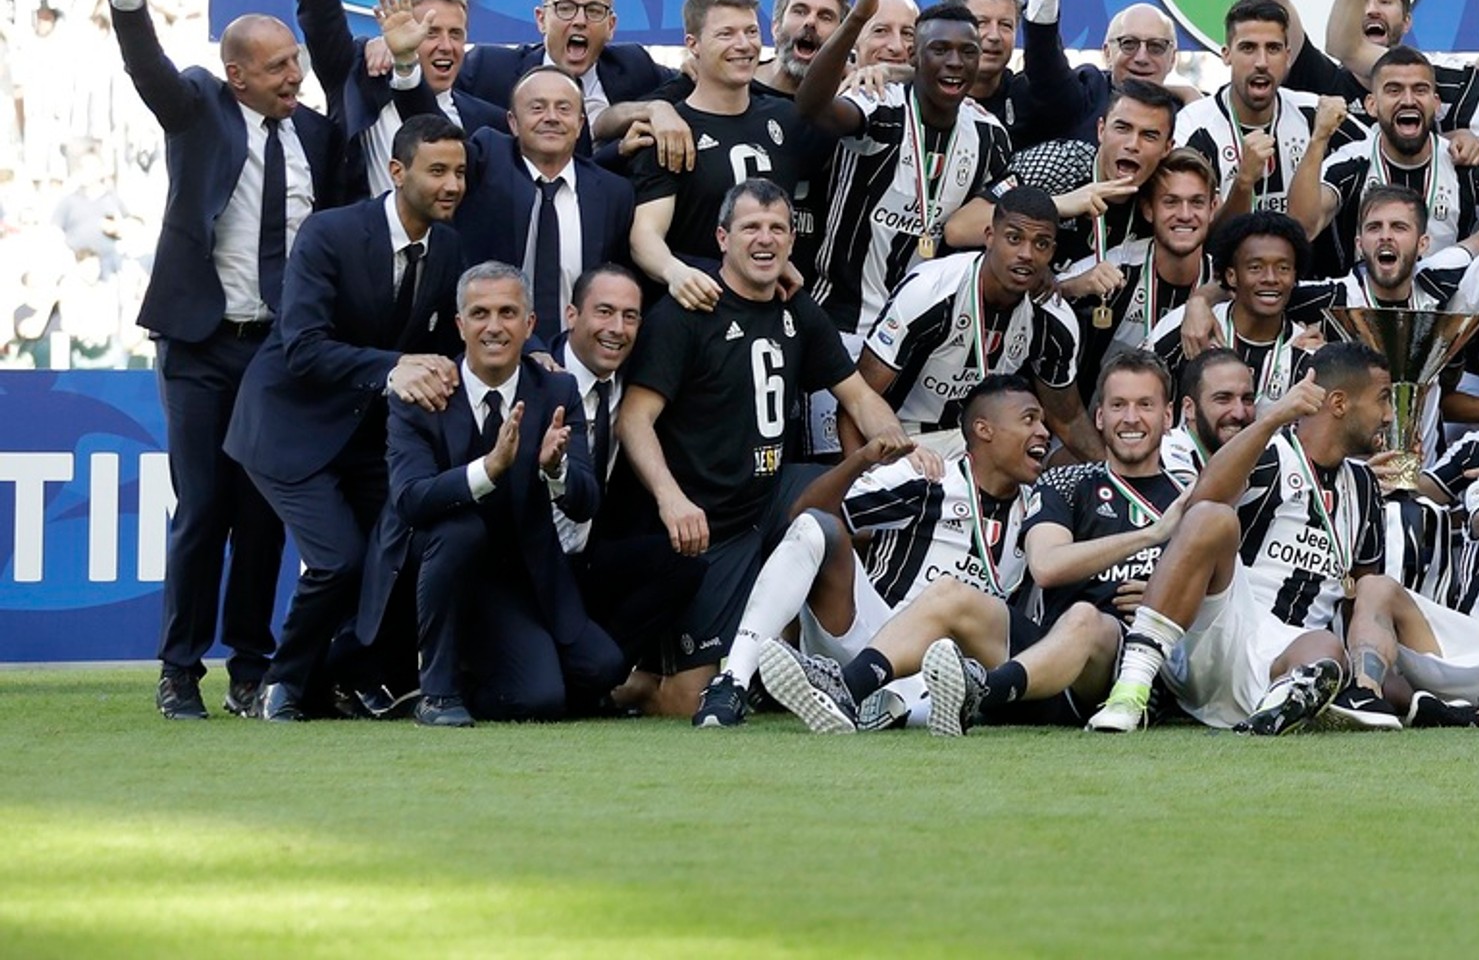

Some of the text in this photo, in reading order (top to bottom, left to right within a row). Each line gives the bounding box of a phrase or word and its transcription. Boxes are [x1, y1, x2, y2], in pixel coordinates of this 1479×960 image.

[873, 207, 944, 237] COMP
[750, 338, 785, 439] 6
[924, 375, 976, 399] COMP
[955, 556, 989, 584] Jee
